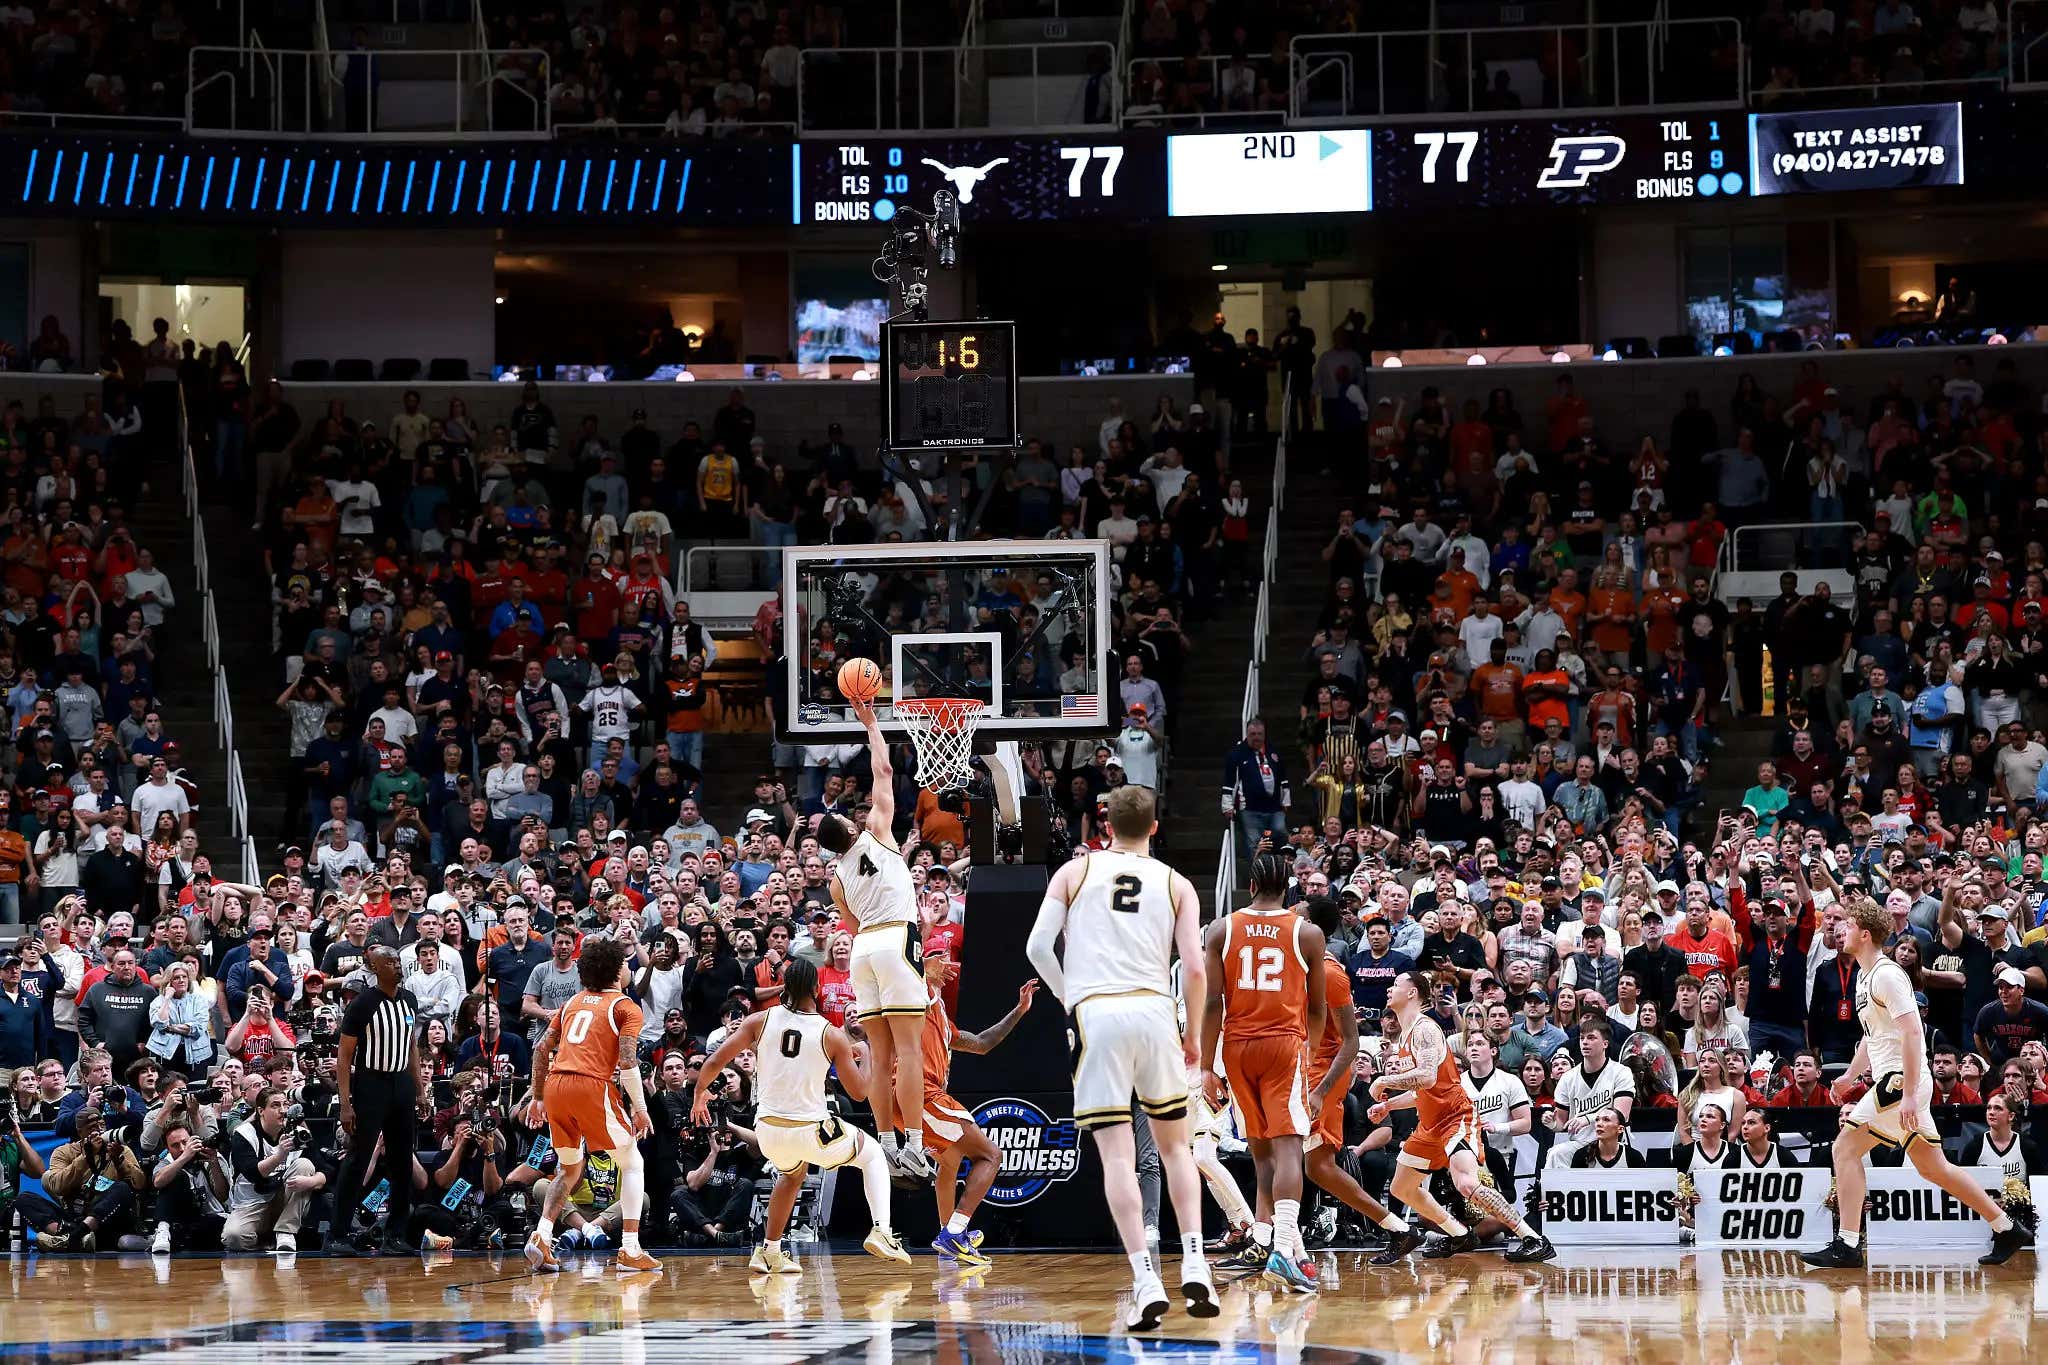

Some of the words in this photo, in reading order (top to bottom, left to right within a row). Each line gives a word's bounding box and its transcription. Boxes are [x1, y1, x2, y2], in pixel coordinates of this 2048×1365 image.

[1660, 121, 1692, 142] TOL
[1709, 122, 1720, 140] 1
[1794, 129, 1844, 149] TEXT
[1849, 125, 1923, 145] ASSIST
[839, 146, 870, 166] TOL
[888, 148, 902, 167] 0
[1244, 135, 1296, 160] 2ND
[1414, 131, 1479, 184] 77
[1061, 146, 1124, 198] 77
[1664, 151, 1693, 172] FLS
[1711, 150, 1724, 169] 9
[1773, 146, 1945, 177] (940)427-7478
[842, 175, 870, 195] FLS
[884, 174, 908, 194] 10
[1637, 177, 1693, 199] BONUS
[815, 201, 870, 221] BONUS
[938, 335, 980, 369] 1.6
[922, 438, 985, 446] DAKTRONICS
[1641, 464, 1656, 481] 12
[599, 711, 618, 727] 25
[858, 852, 879, 879] 4
[1112, 873, 1143, 914] 2
[1244, 923, 1282, 940] MARK
[408, 959, 450, 976] PUUE
[1237, 945, 1286, 992] 12
[1684, 953, 1719, 967] RIZONA
[1355, 967, 1397, 978] ARIZONA
[545, 980, 576, 993] Strand
[104, 995, 144, 1004] ARKANSAS
[566, 1009, 594, 1045] 0
[780, 1028, 803, 1059] 0
[985, 1106, 1012, 1119] SWEET
[1014, 1106, 1024, 1116] 16
[1475, 1094, 1503, 1113] due
[1573, 1089, 1612, 1116] Purdue
[999, 1149, 1076, 1171] ADNESS
[991, 1188, 1015, 1198] ELITE
[1017, 1188, 1023, 1196] 8
[1719, 1172, 1804, 1203] CHOO
[1545, 1190, 1675, 1222] BOILERS
[1868, 1189, 2001, 1221] BOILE
[1720, 1208, 1805, 1240] CHOO
